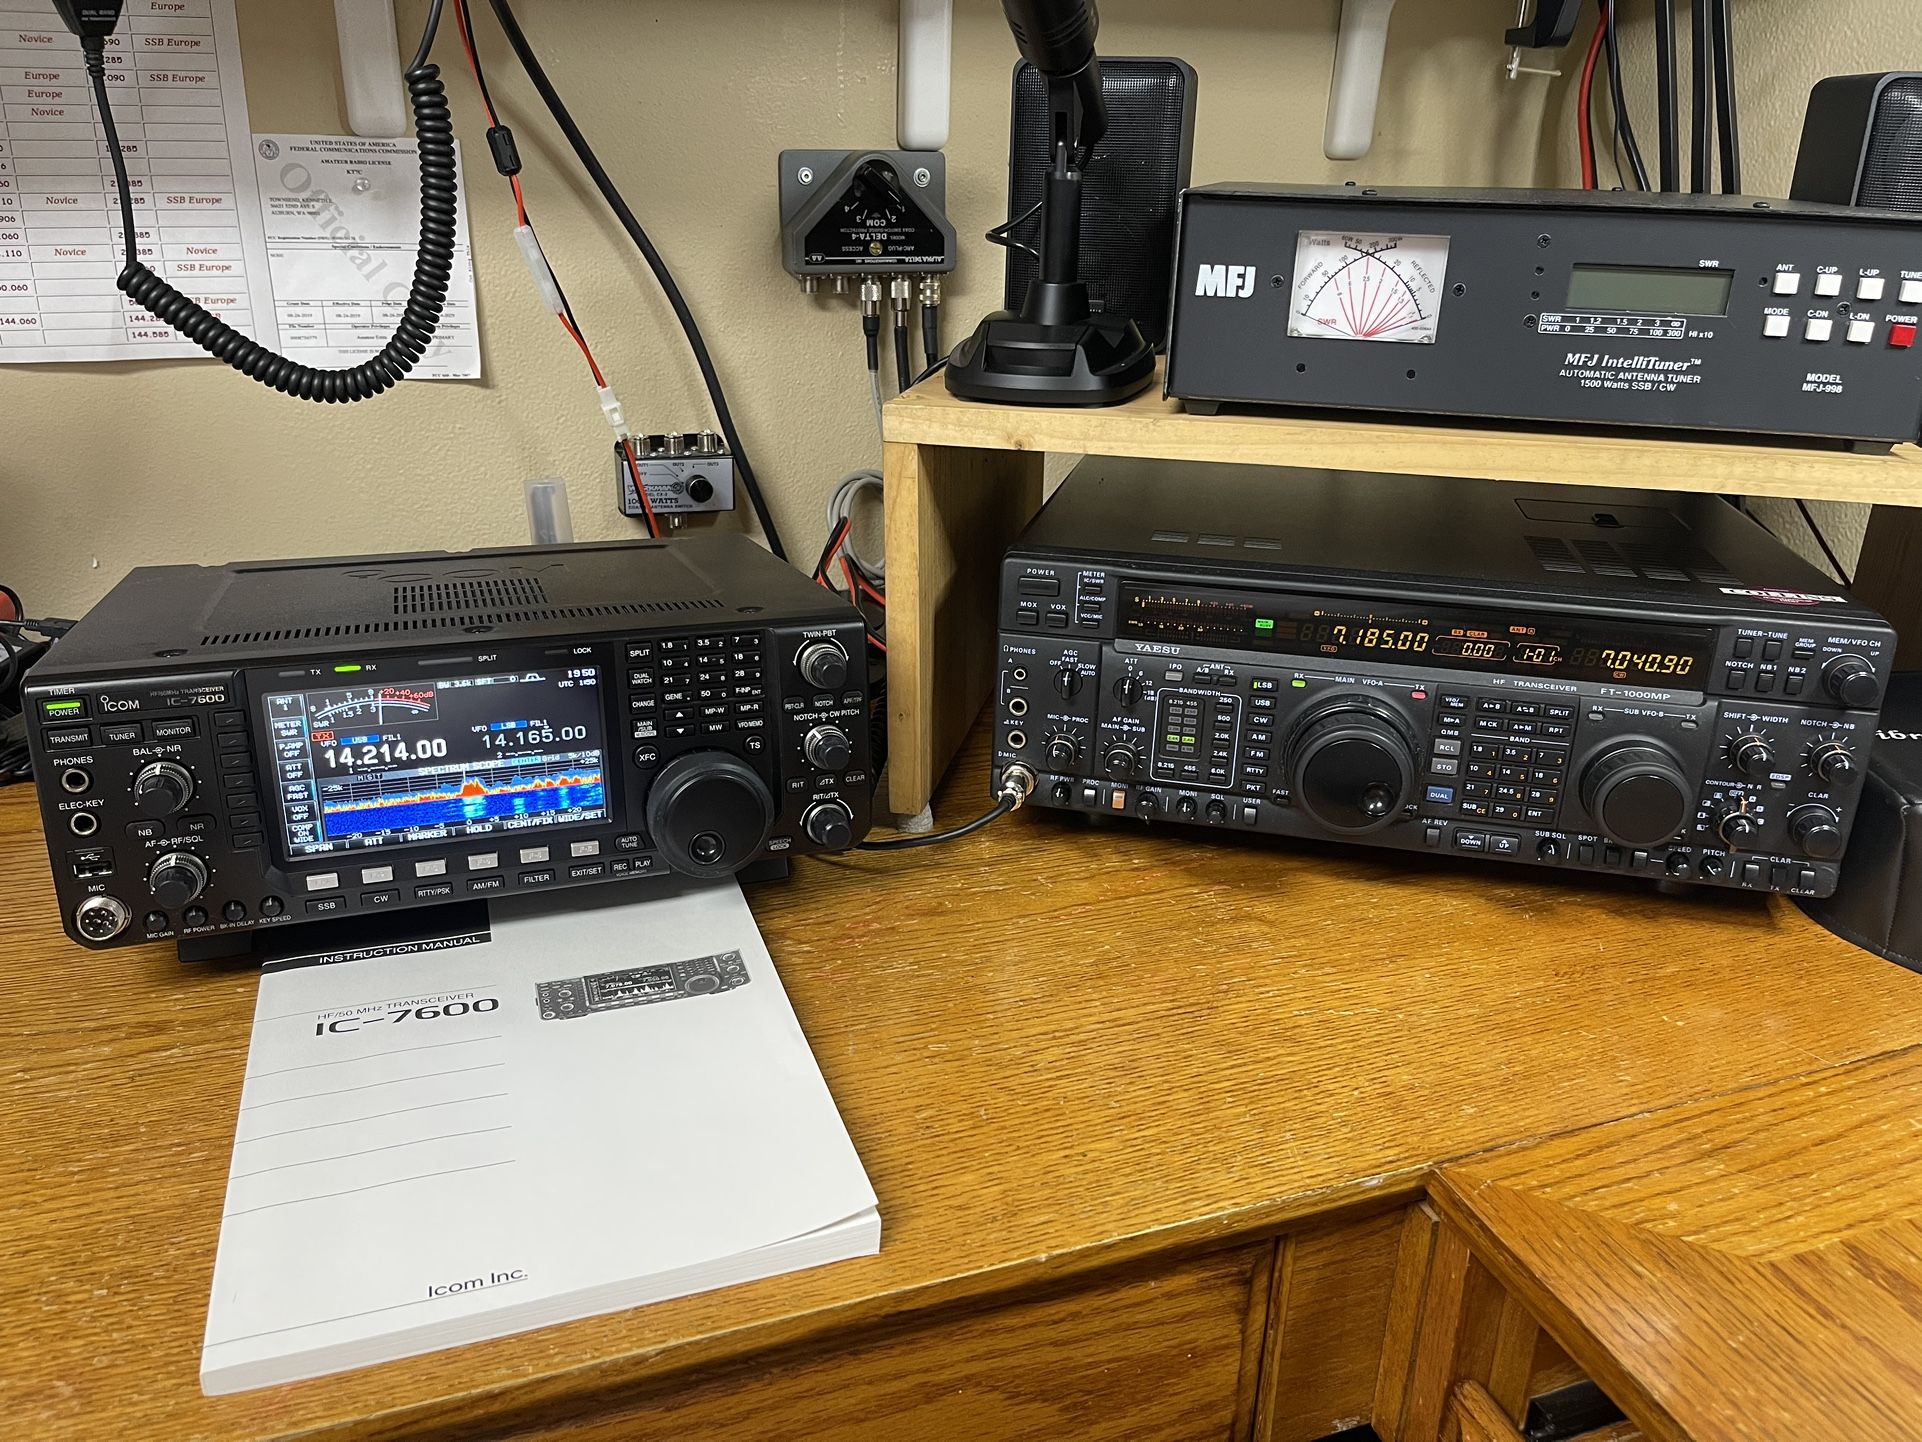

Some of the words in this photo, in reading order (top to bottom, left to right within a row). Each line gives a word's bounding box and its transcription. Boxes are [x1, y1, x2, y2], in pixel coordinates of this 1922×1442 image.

[151, 2, 185, 11] Europe
[19, 35, 53, 44] Novice
[167, 39, 201, 47] Europe
[24, 72, 60, 81] Europe
[172, 75, 206, 83] Europe
[27, 90, 63, 99] Europe
[46, 197, 78, 205] Novice
[167, 196, 186, 204] SSB
[189, 196, 222, 204] Europe
[54, 248, 87, 256] Novice
[199, 264, 232, 272] Europe
[1298, 262, 1323, 288] FORWARD
[1411, 260, 1435, 294] REFLECTED
[1195, 265, 1256, 297] MFJ
[1886, 315, 1918, 323] POWER
[1565, 353, 1599, 366] MFJ
[1559, 370, 1614, 379] AUTOMATIC
[1618, 372, 1664, 381] ANTENNA
[1667, 374, 1700, 383] TUNER
[1807, 373, 1842, 383] MODEL
[1604, 381, 1629, 389] Watts
[1632, 382, 1651, 390] SSB
[1802, 384, 1842, 393] MFJ-998
[803, 630, 836, 638] TWIN-PBT
[1334, 626, 1429, 651] 7.185.00
[1869, 640, 1881, 648] CH
[1135, 644, 1180, 655] YAESU
[1602, 650, 1693, 675] 7.040.90
[1725, 661, 1754, 669] NOTCH
[1335, 676, 1355, 684] MAIN
[1513, 680, 1577, 692] TRANSCEIVER
[1179, 688, 1220, 696] BANDWIDTH
[1600, 688, 1671, 700] FT-1000MP
[167, 694, 225, 706] IC-7600
[49, 708, 79, 716] POWER
[1550, 709, 1569, 717] SPLIT
[1724, 712, 1746, 720] SHIFT
[794, 713, 817, 721] NOTCH
[1254, 716, 1268, 724] CW
[1801, 719, 1827, 727] NOTCH
[157, 727, 191, 736] MONITOR
[50, 734, 88, 743] TRANSMIT
[109, 733, 135, 741] TUNER
[483, 726, 586, 749] 14.165.00
[133, 748, 152, 756] BAL
[325, 739, 447, 768] 14.214.00
[54, 756, 93, 766] PHONES
[845, 774, 865, 782] CLEAR
[59, 799, 104, 810] ELEC-KEY
[558, 812, 602, 823] WIDE/SET
[508, 817, 553, 829] CENT/FIX
[466, 825, 492, 834] HOLD
[408, 829, 447, 841] MARKER
[145, 840, 156, 848] AF
[171, 836, 204, 845] RF/SQL
[365, 837, 383, 846] ATT
[305, 843, 333, 853] SPAN
[1703, 848, 1725, 856] PITCH
[614, 863, 628, 871] REC
[635, 859, 651, 868] PLAY
[572, 867, 601, 877] EXIT/SET
[524, 874, 550, 883] FILTER
[89, 884, 105, 893] MIC
[473, 880, 499, 890] AM/FM
[418, 887, 451, 897] RTTY/PSK
[374, 895, 388, 903] CW
[318, 901, 335, 911] SSB
[320, 945, 418, 963] INSTRUCTION
[422, 937, 480, 950] MANUAL
[318, 1010, 353, 1020] HF/50
[357, 1006, 382, 1015] MHz
[388, 992, 474, 1009] TRANSCEIVER
[316, 998, 499, 1036] IC-7600
[429, 1278, 483, 1297] Icom
[491, 1270, 528, 1283] Inc.
